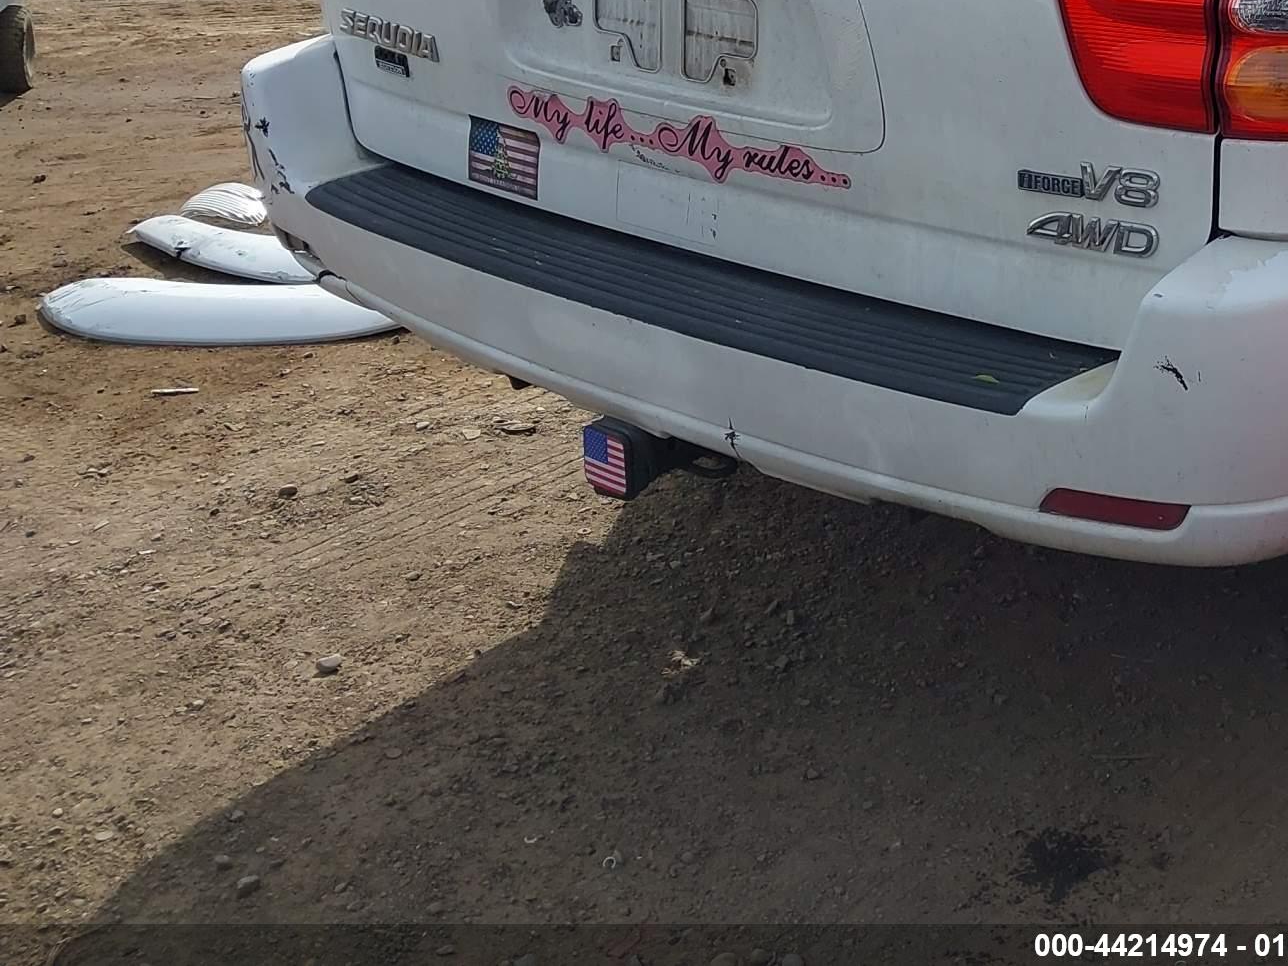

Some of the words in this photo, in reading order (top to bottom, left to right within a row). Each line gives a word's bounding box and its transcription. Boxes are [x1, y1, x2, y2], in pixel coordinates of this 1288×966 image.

[340, 8, 440, 63] SEQUOIA
[509, 89, 571, 141] My
[658, 119, 734, 181] My
[1080, 161, 1161, 208] V8
[1026, 211, 1160, 259] 4WD
